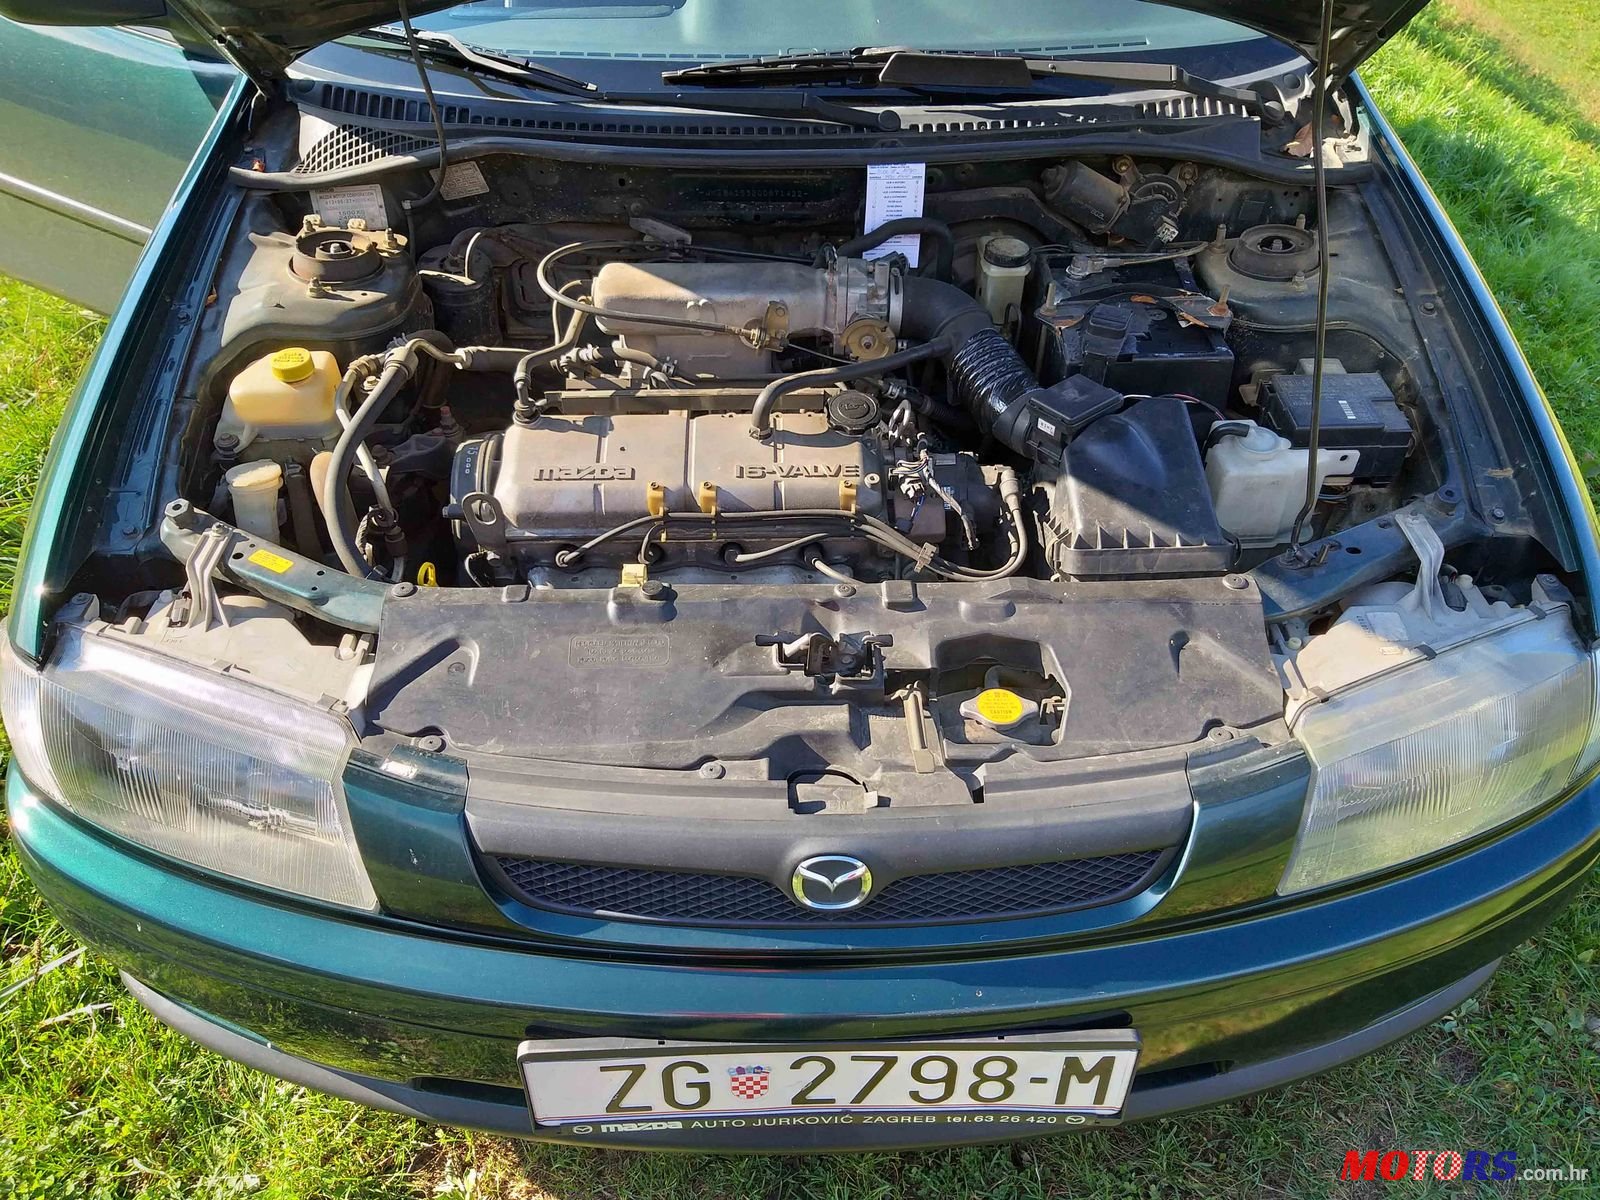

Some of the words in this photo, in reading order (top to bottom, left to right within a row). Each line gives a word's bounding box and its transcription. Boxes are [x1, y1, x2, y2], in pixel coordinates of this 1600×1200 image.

[735, 463, 860, 479] 16-VALVE
[599, 1060, 711, 1114] ZG
[789, 1055, 1116, 1105] 2798-M
[691, 1119, 747, 1129] AUTO
[752, 1114, 853, 1127] JURKOVIĆ
[862, 1115, 936, 1123] ZAGREB
[999, 1115, 1020, 1123] 26
[1025, 1116, 1057, 1124] 420
